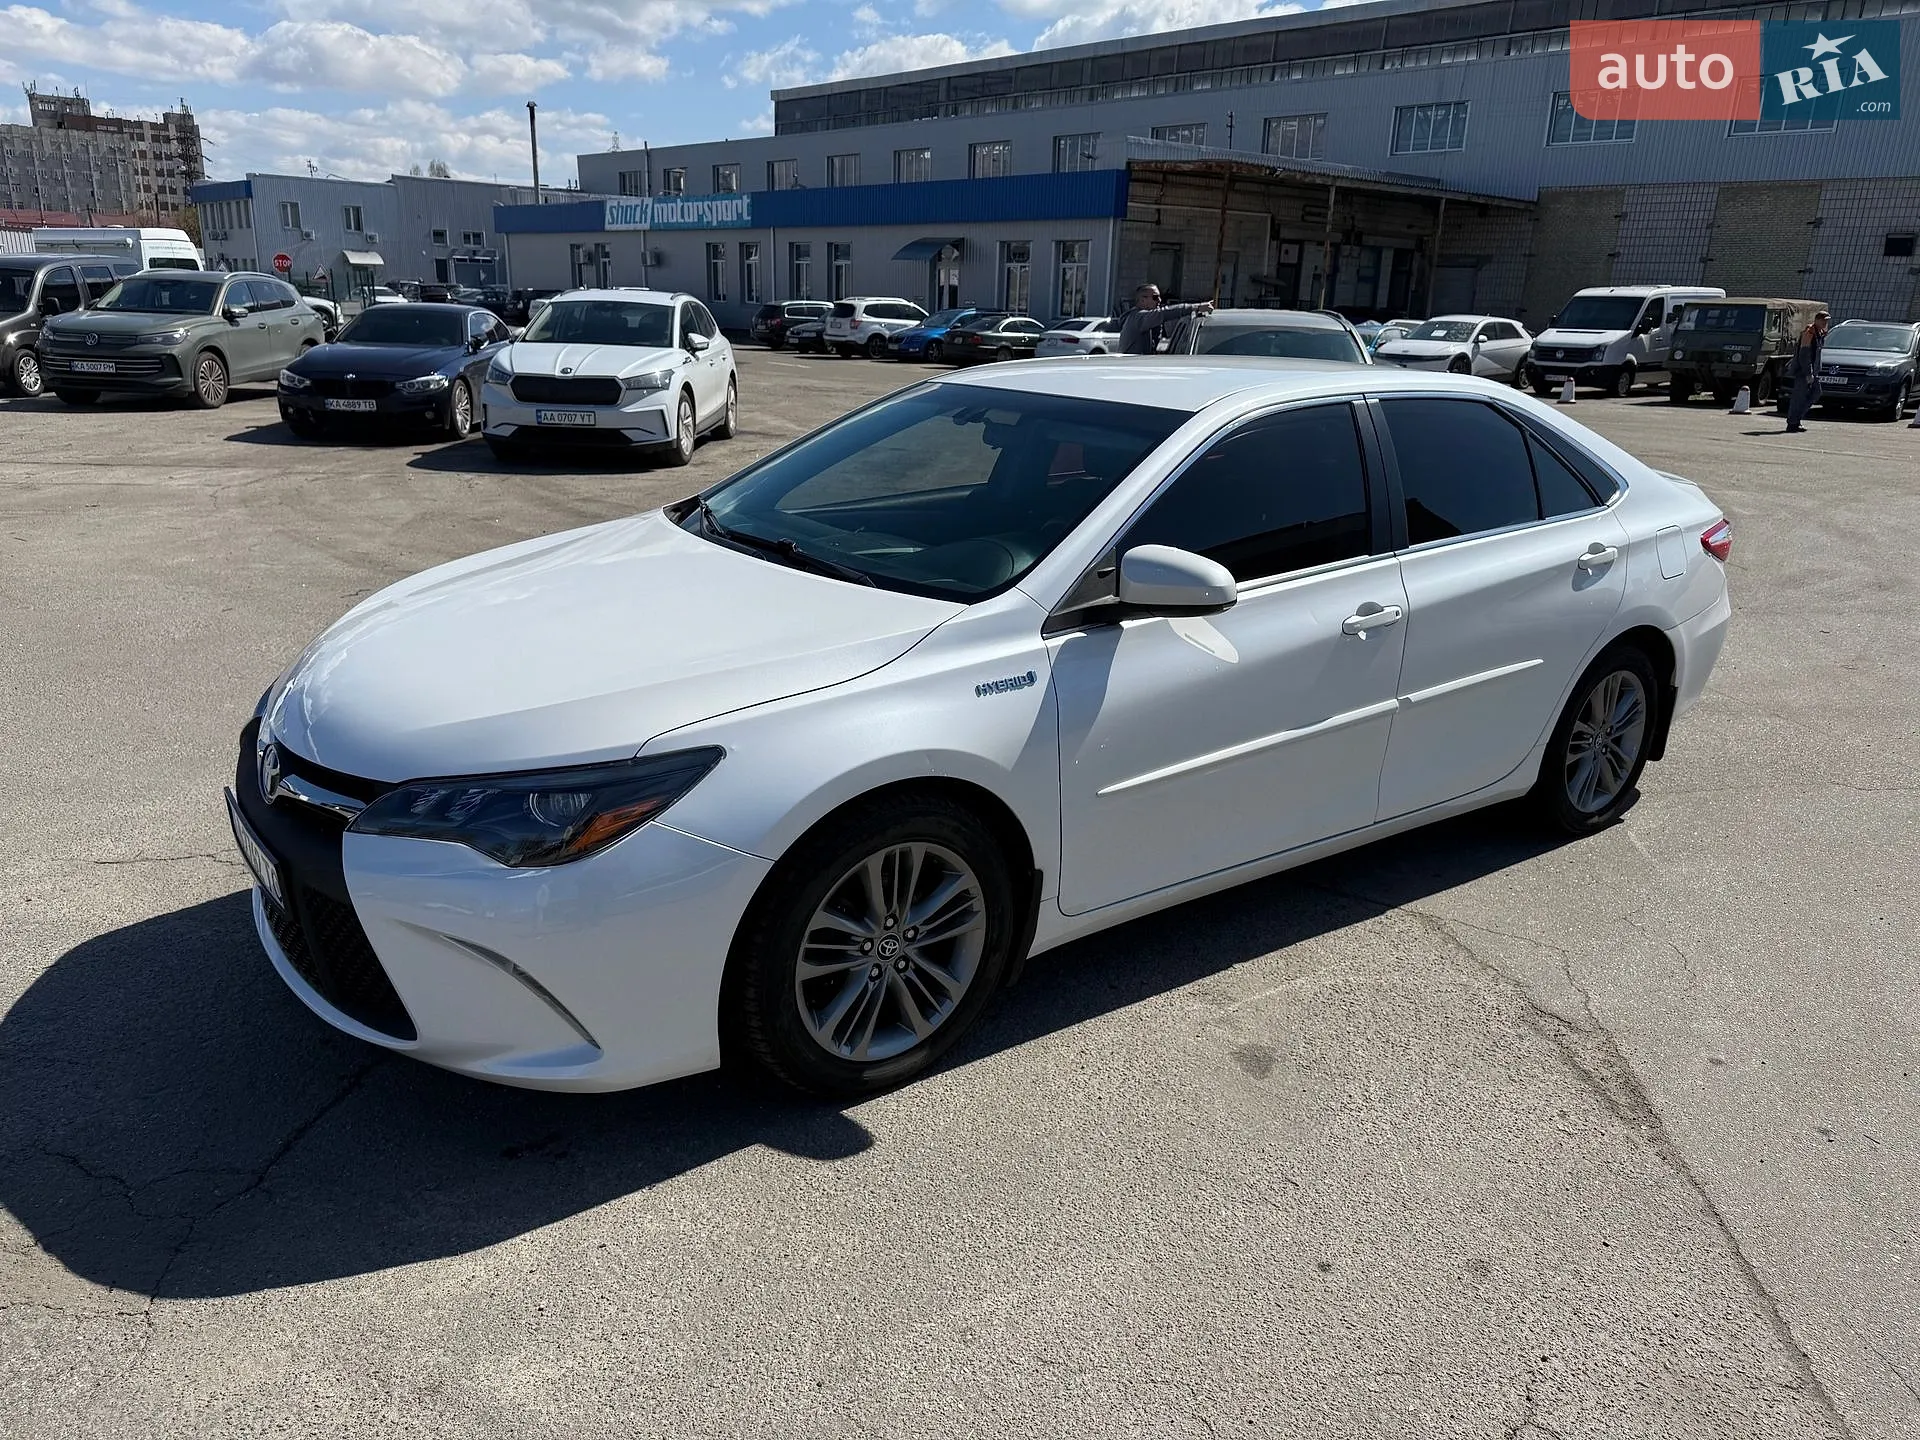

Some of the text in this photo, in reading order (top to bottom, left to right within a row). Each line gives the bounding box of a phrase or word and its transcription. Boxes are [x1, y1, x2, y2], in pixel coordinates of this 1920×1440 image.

[607, 195, 751, 226] shock motorsport
[274, 259, 292, 268] STOP
[543, 412, 593, 423] AA 0707 YT
